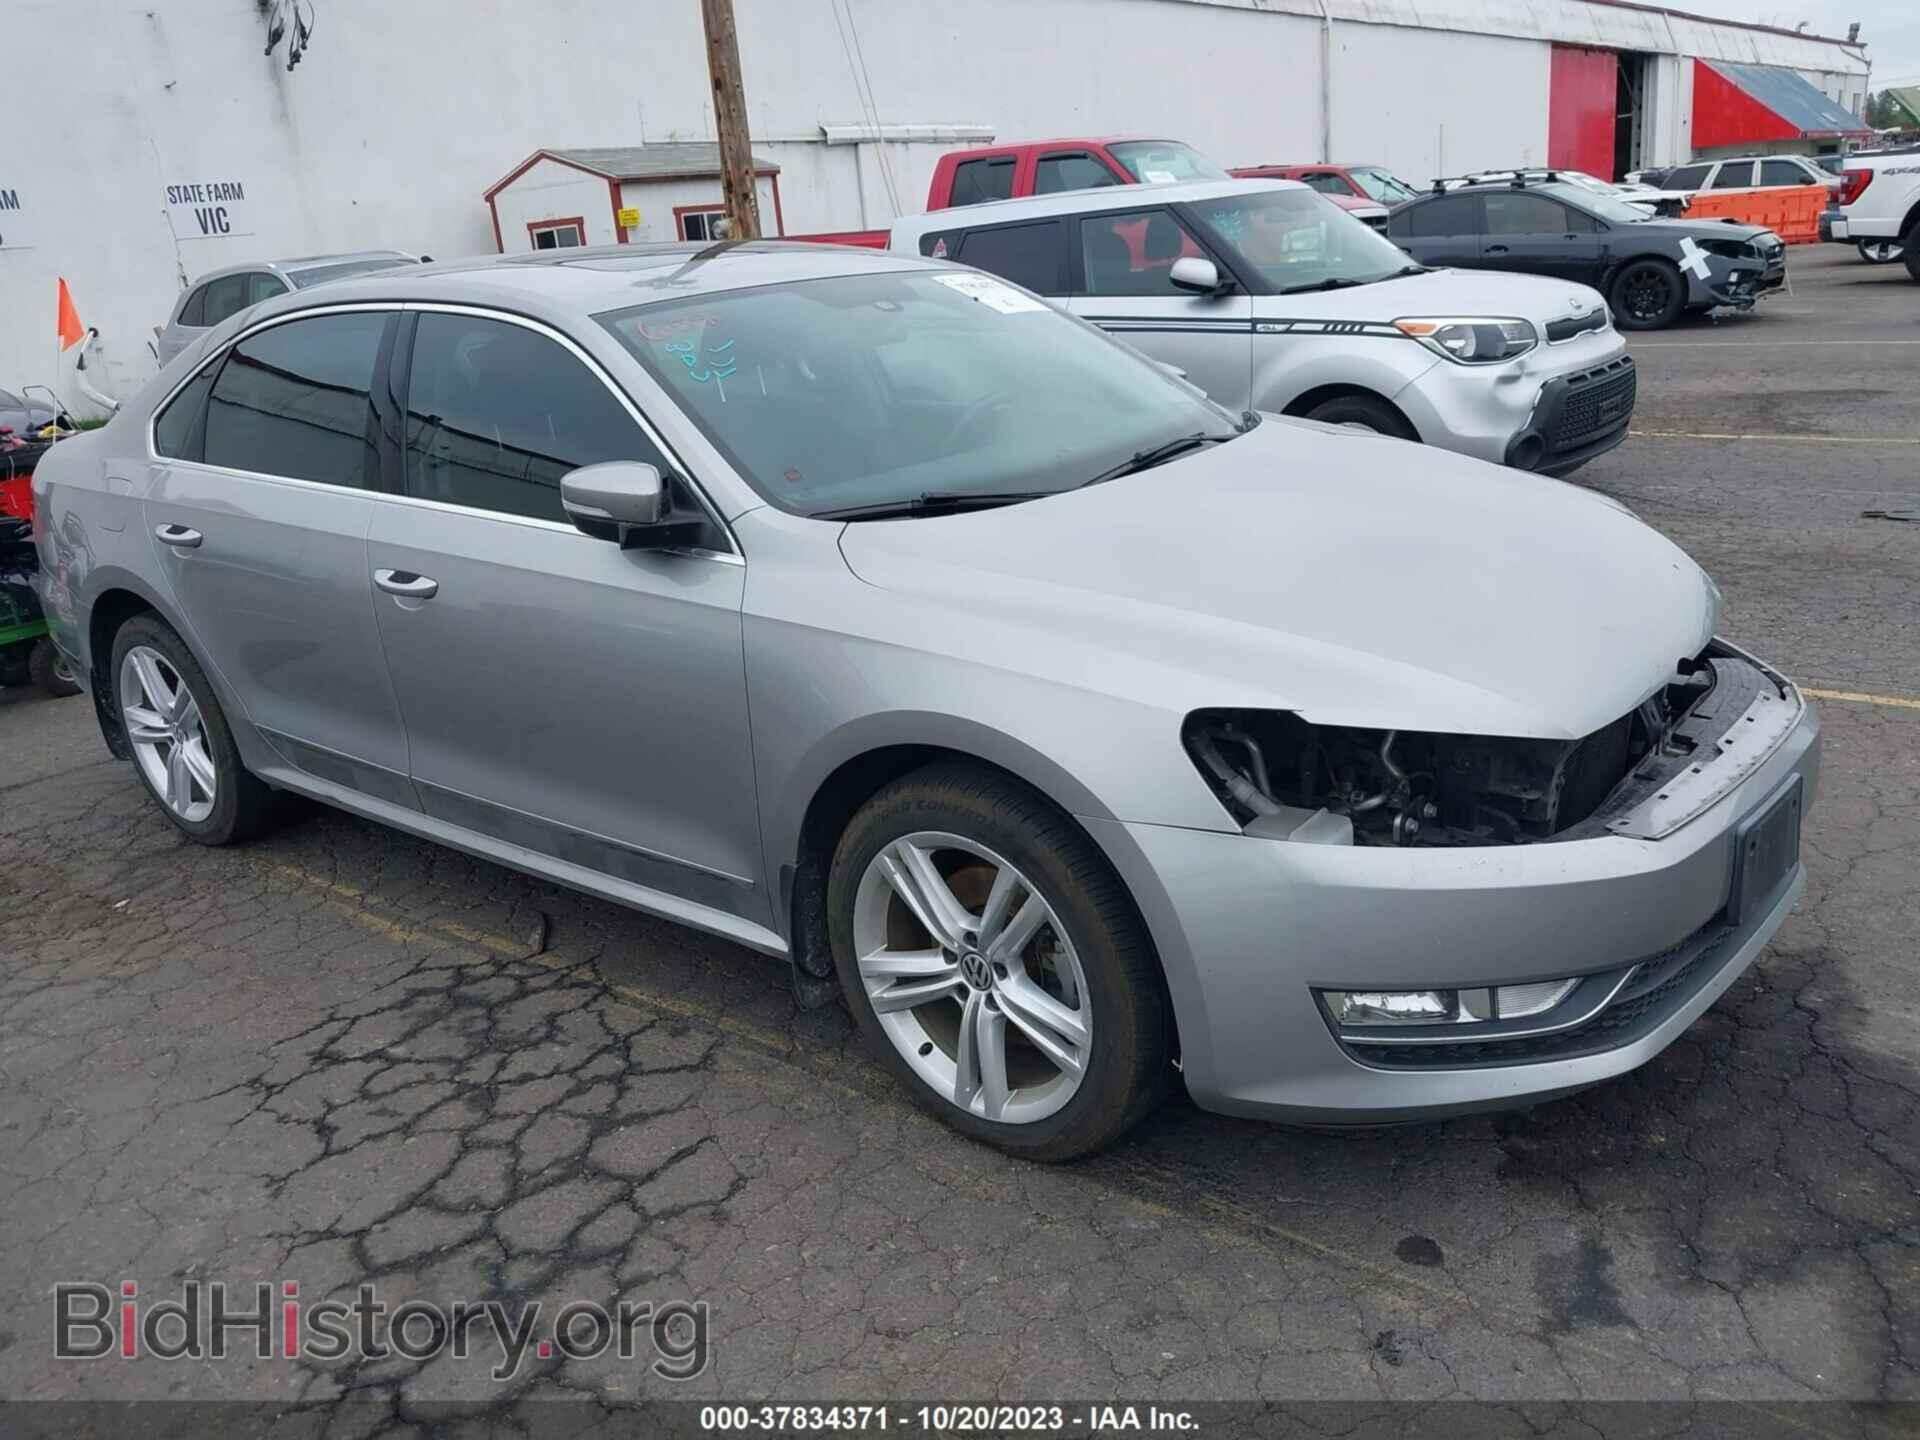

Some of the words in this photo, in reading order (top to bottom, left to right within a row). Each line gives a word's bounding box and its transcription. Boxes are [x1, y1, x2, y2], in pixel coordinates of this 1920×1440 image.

[167, 184, 205, 204] STATE
[206, 182, 245, 202] FARM
[194, 206, 230, 234] VIC
